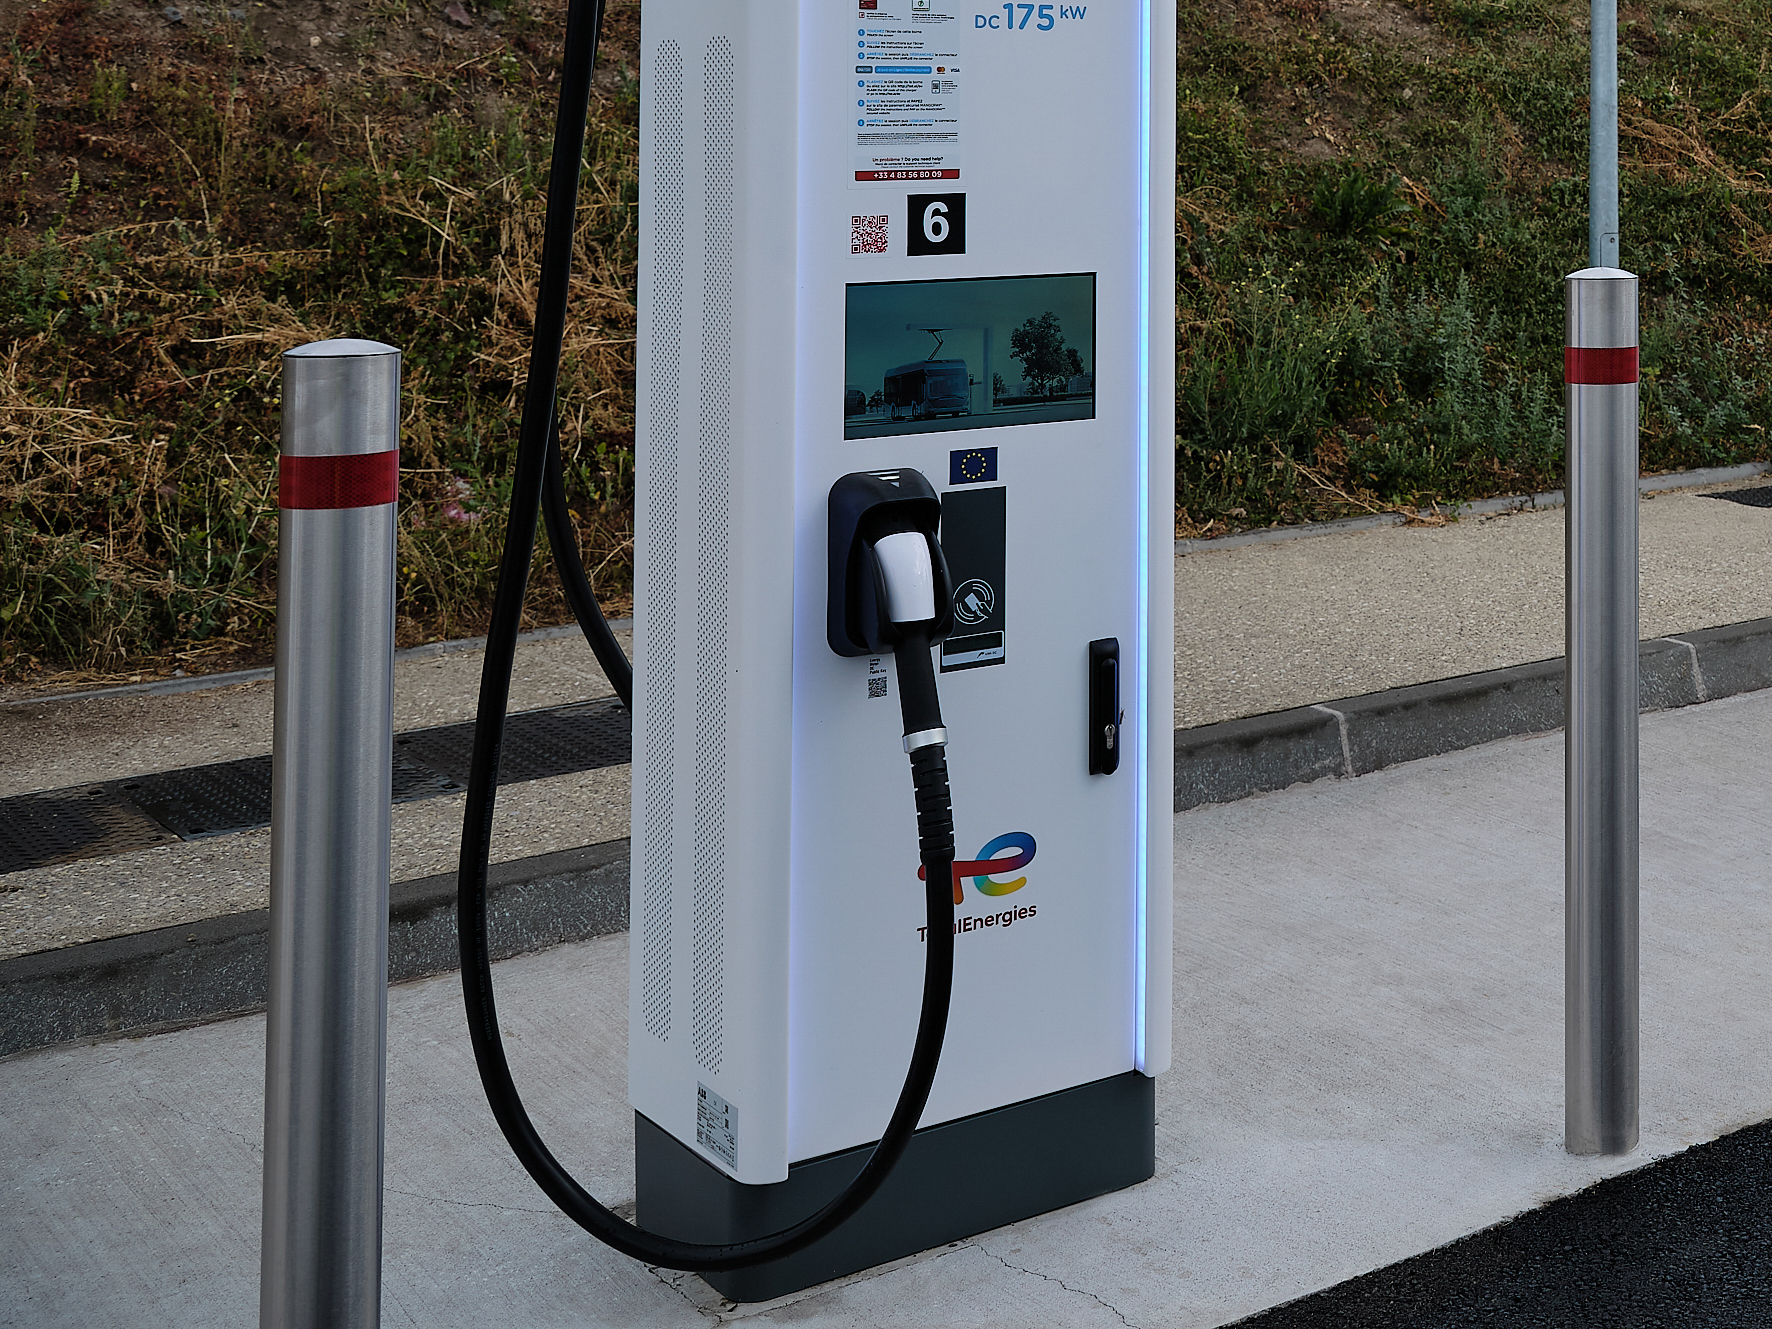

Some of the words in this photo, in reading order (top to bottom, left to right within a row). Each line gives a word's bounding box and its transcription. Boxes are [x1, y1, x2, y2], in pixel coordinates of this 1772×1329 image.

[974, 14, 1000, 30] DC
[1002, 2, 1055, 32] 175
[1060, 4, 1087, 20] kW
[923, 201, 950, 243] 6
[916, 905, 1037, 942] TlEnergies
